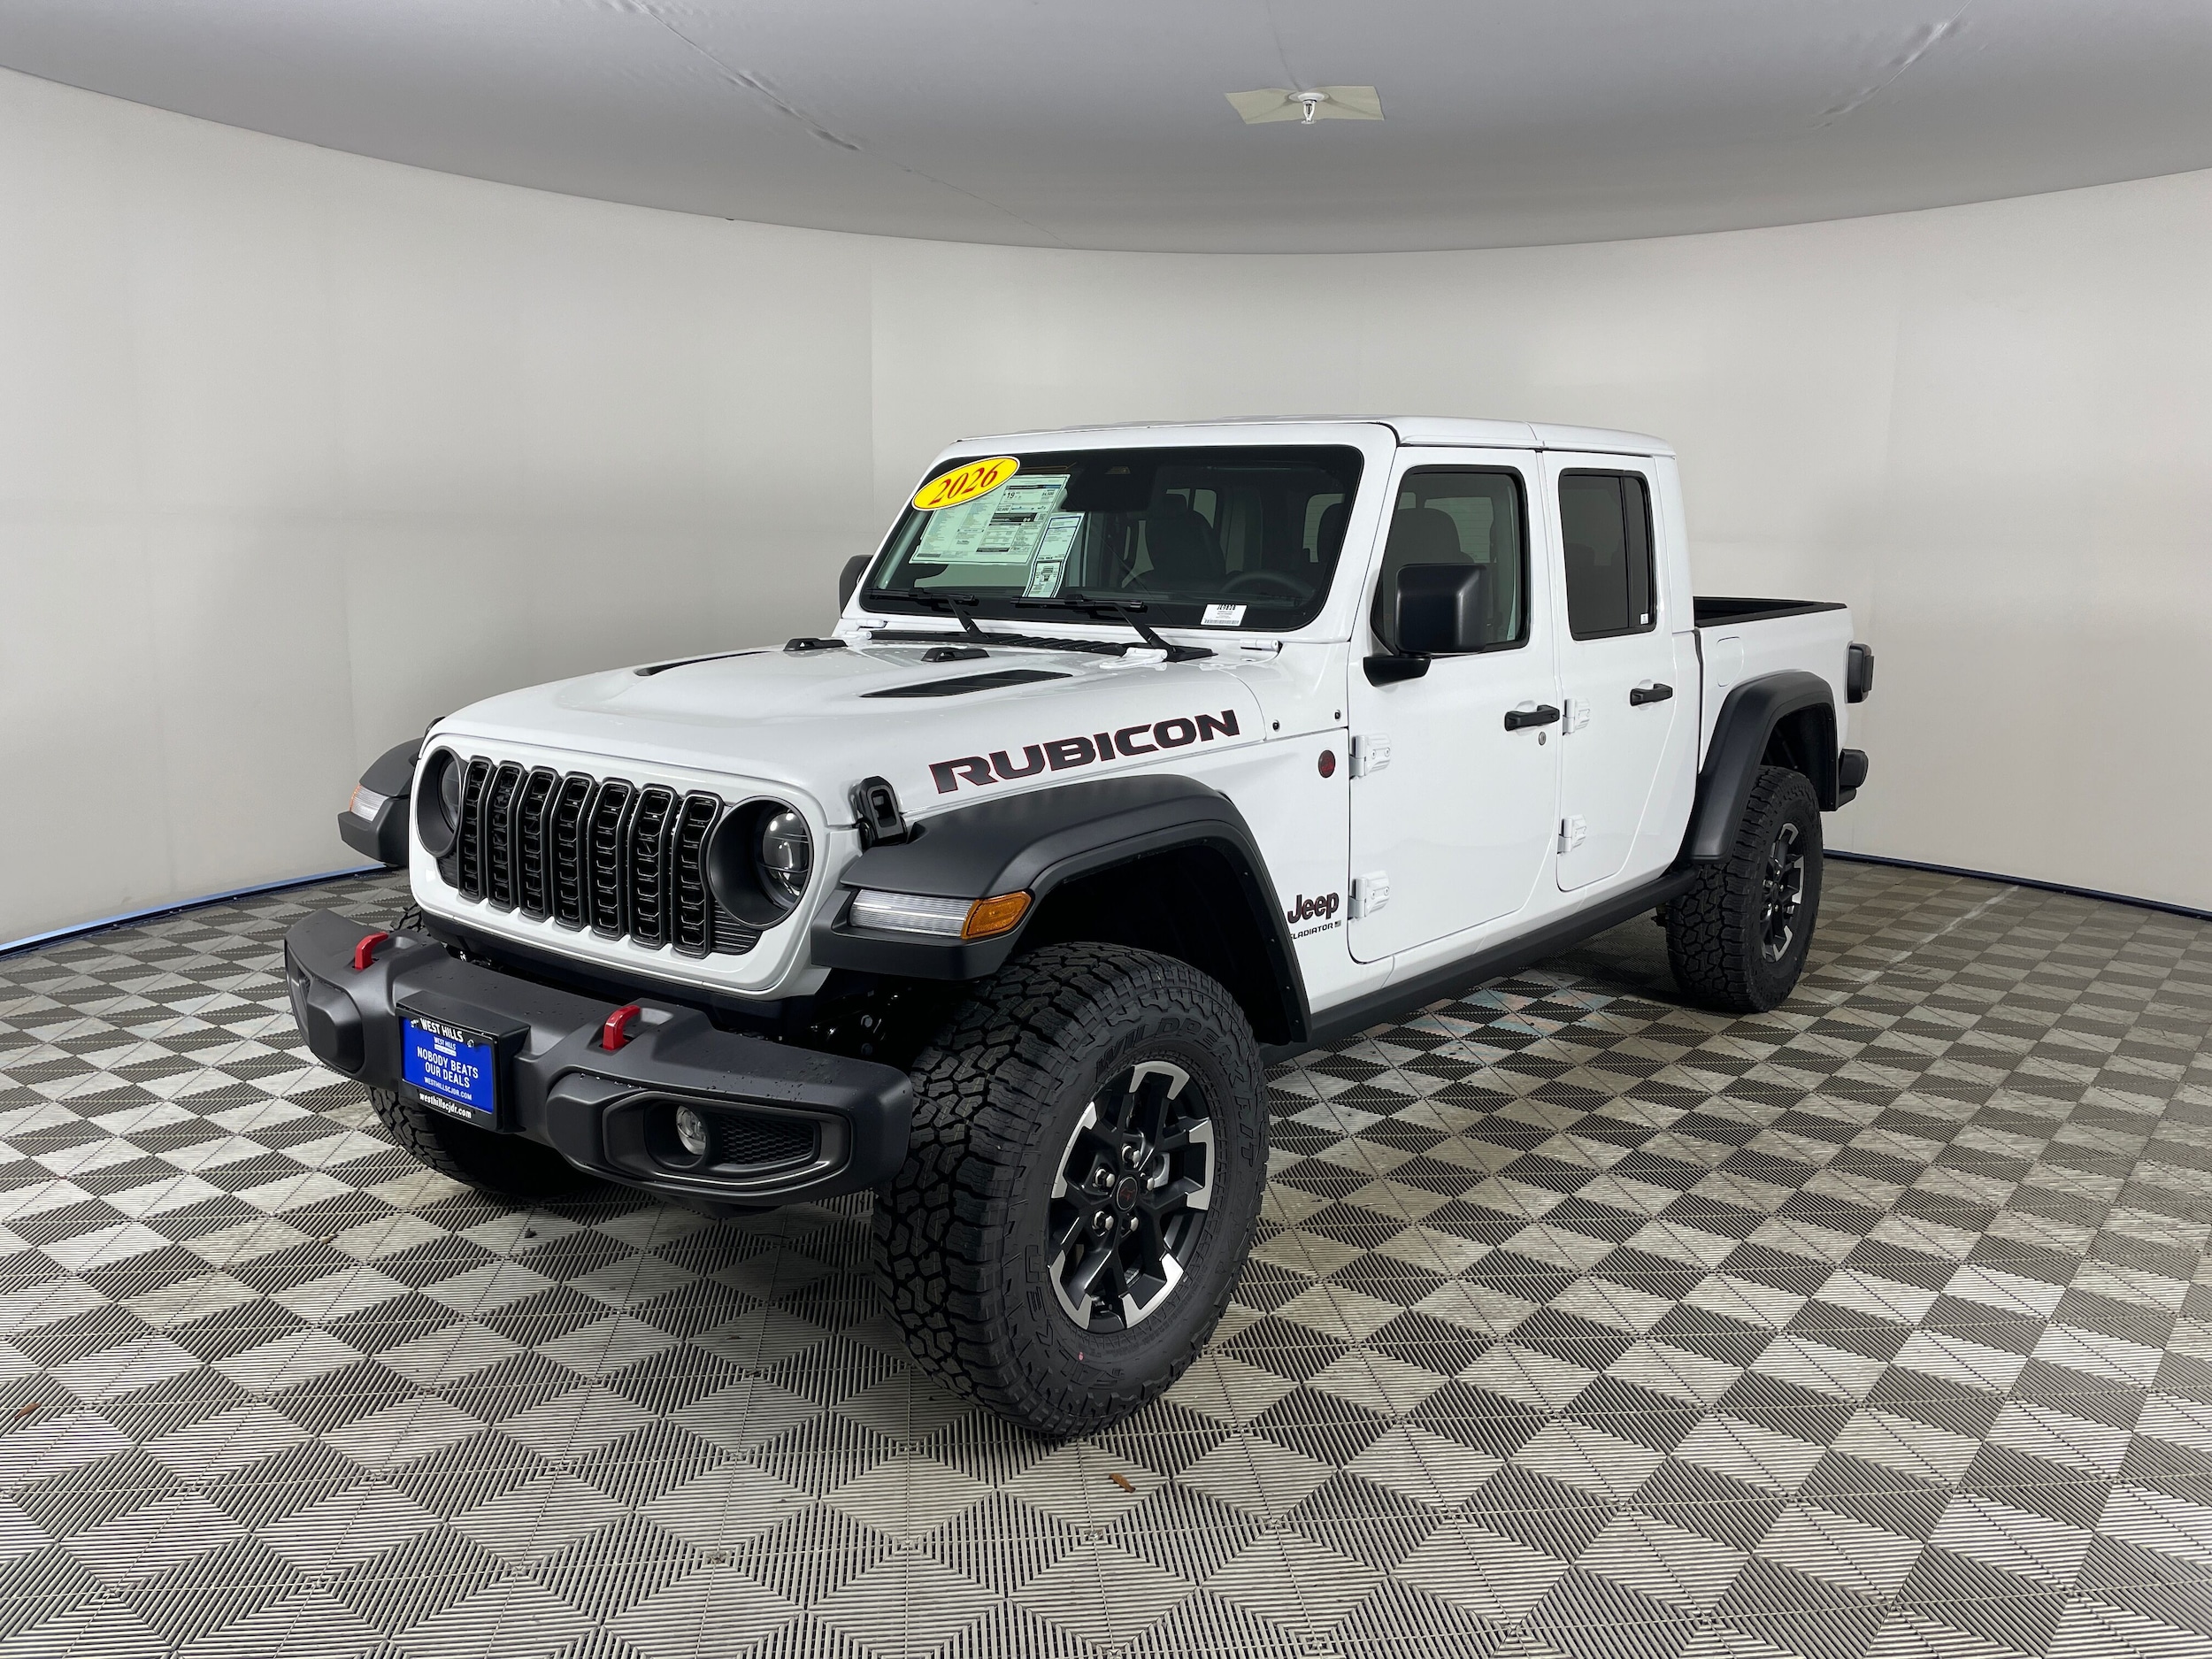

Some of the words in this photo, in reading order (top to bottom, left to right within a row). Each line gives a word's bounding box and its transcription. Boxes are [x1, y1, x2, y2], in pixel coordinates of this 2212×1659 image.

[927, 460, 1006, 505] 2026
[929, 710, 1240, 794] RUBICON
[1287, 892, 1340, 924] Jeep
[419, 1018, 440, 1034] WEST
[442, 1025, 464, 1042] HILLS
[434, 1036, 444, 1046] WEST
[445, 1041, 457, 1050] HILLS
[417, 1046, 448, 1068] NOBODY
[450, 1060, 479, 1079] BEATS
[1096, 1018, 1246, 1089] WILDPEAK
[424, 1076, 472, 1101] WESTHILLSCJDR.COM
[425, 1062, 442, 1078] OUR
[442, 1069, 470, 1088] DEALS
[419, 1093, 472, 1118] westhillscjdr.com
